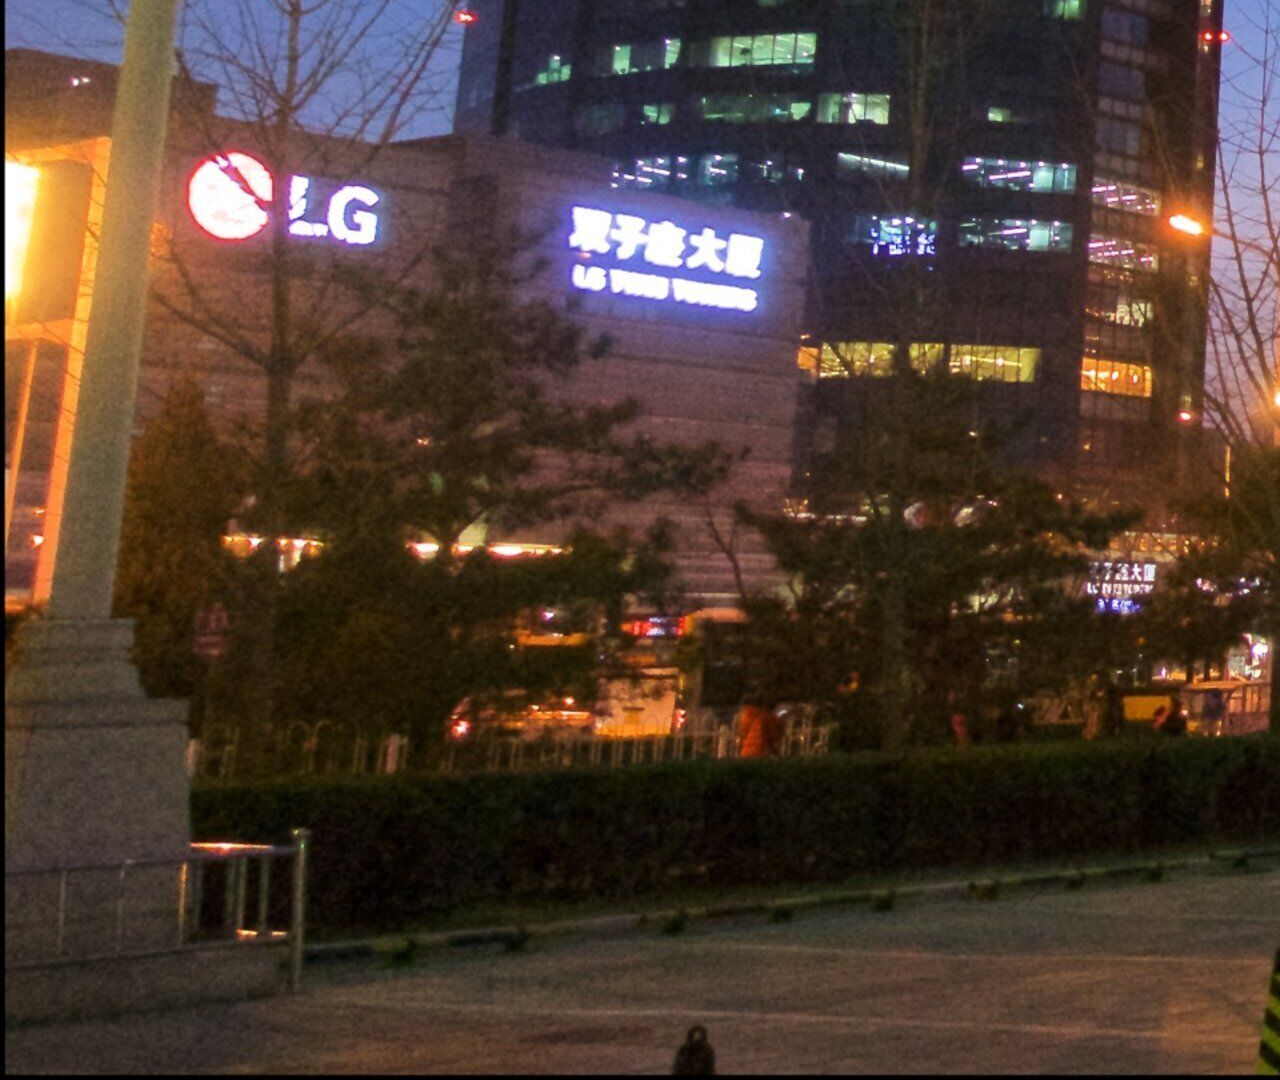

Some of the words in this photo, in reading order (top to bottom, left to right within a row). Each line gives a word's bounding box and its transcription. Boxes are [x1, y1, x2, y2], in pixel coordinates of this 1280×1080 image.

[287, 174, 380, 245] LG
[568, 205, 765, 279] 双子座大厦
[571, 263, 607, 292] LG
